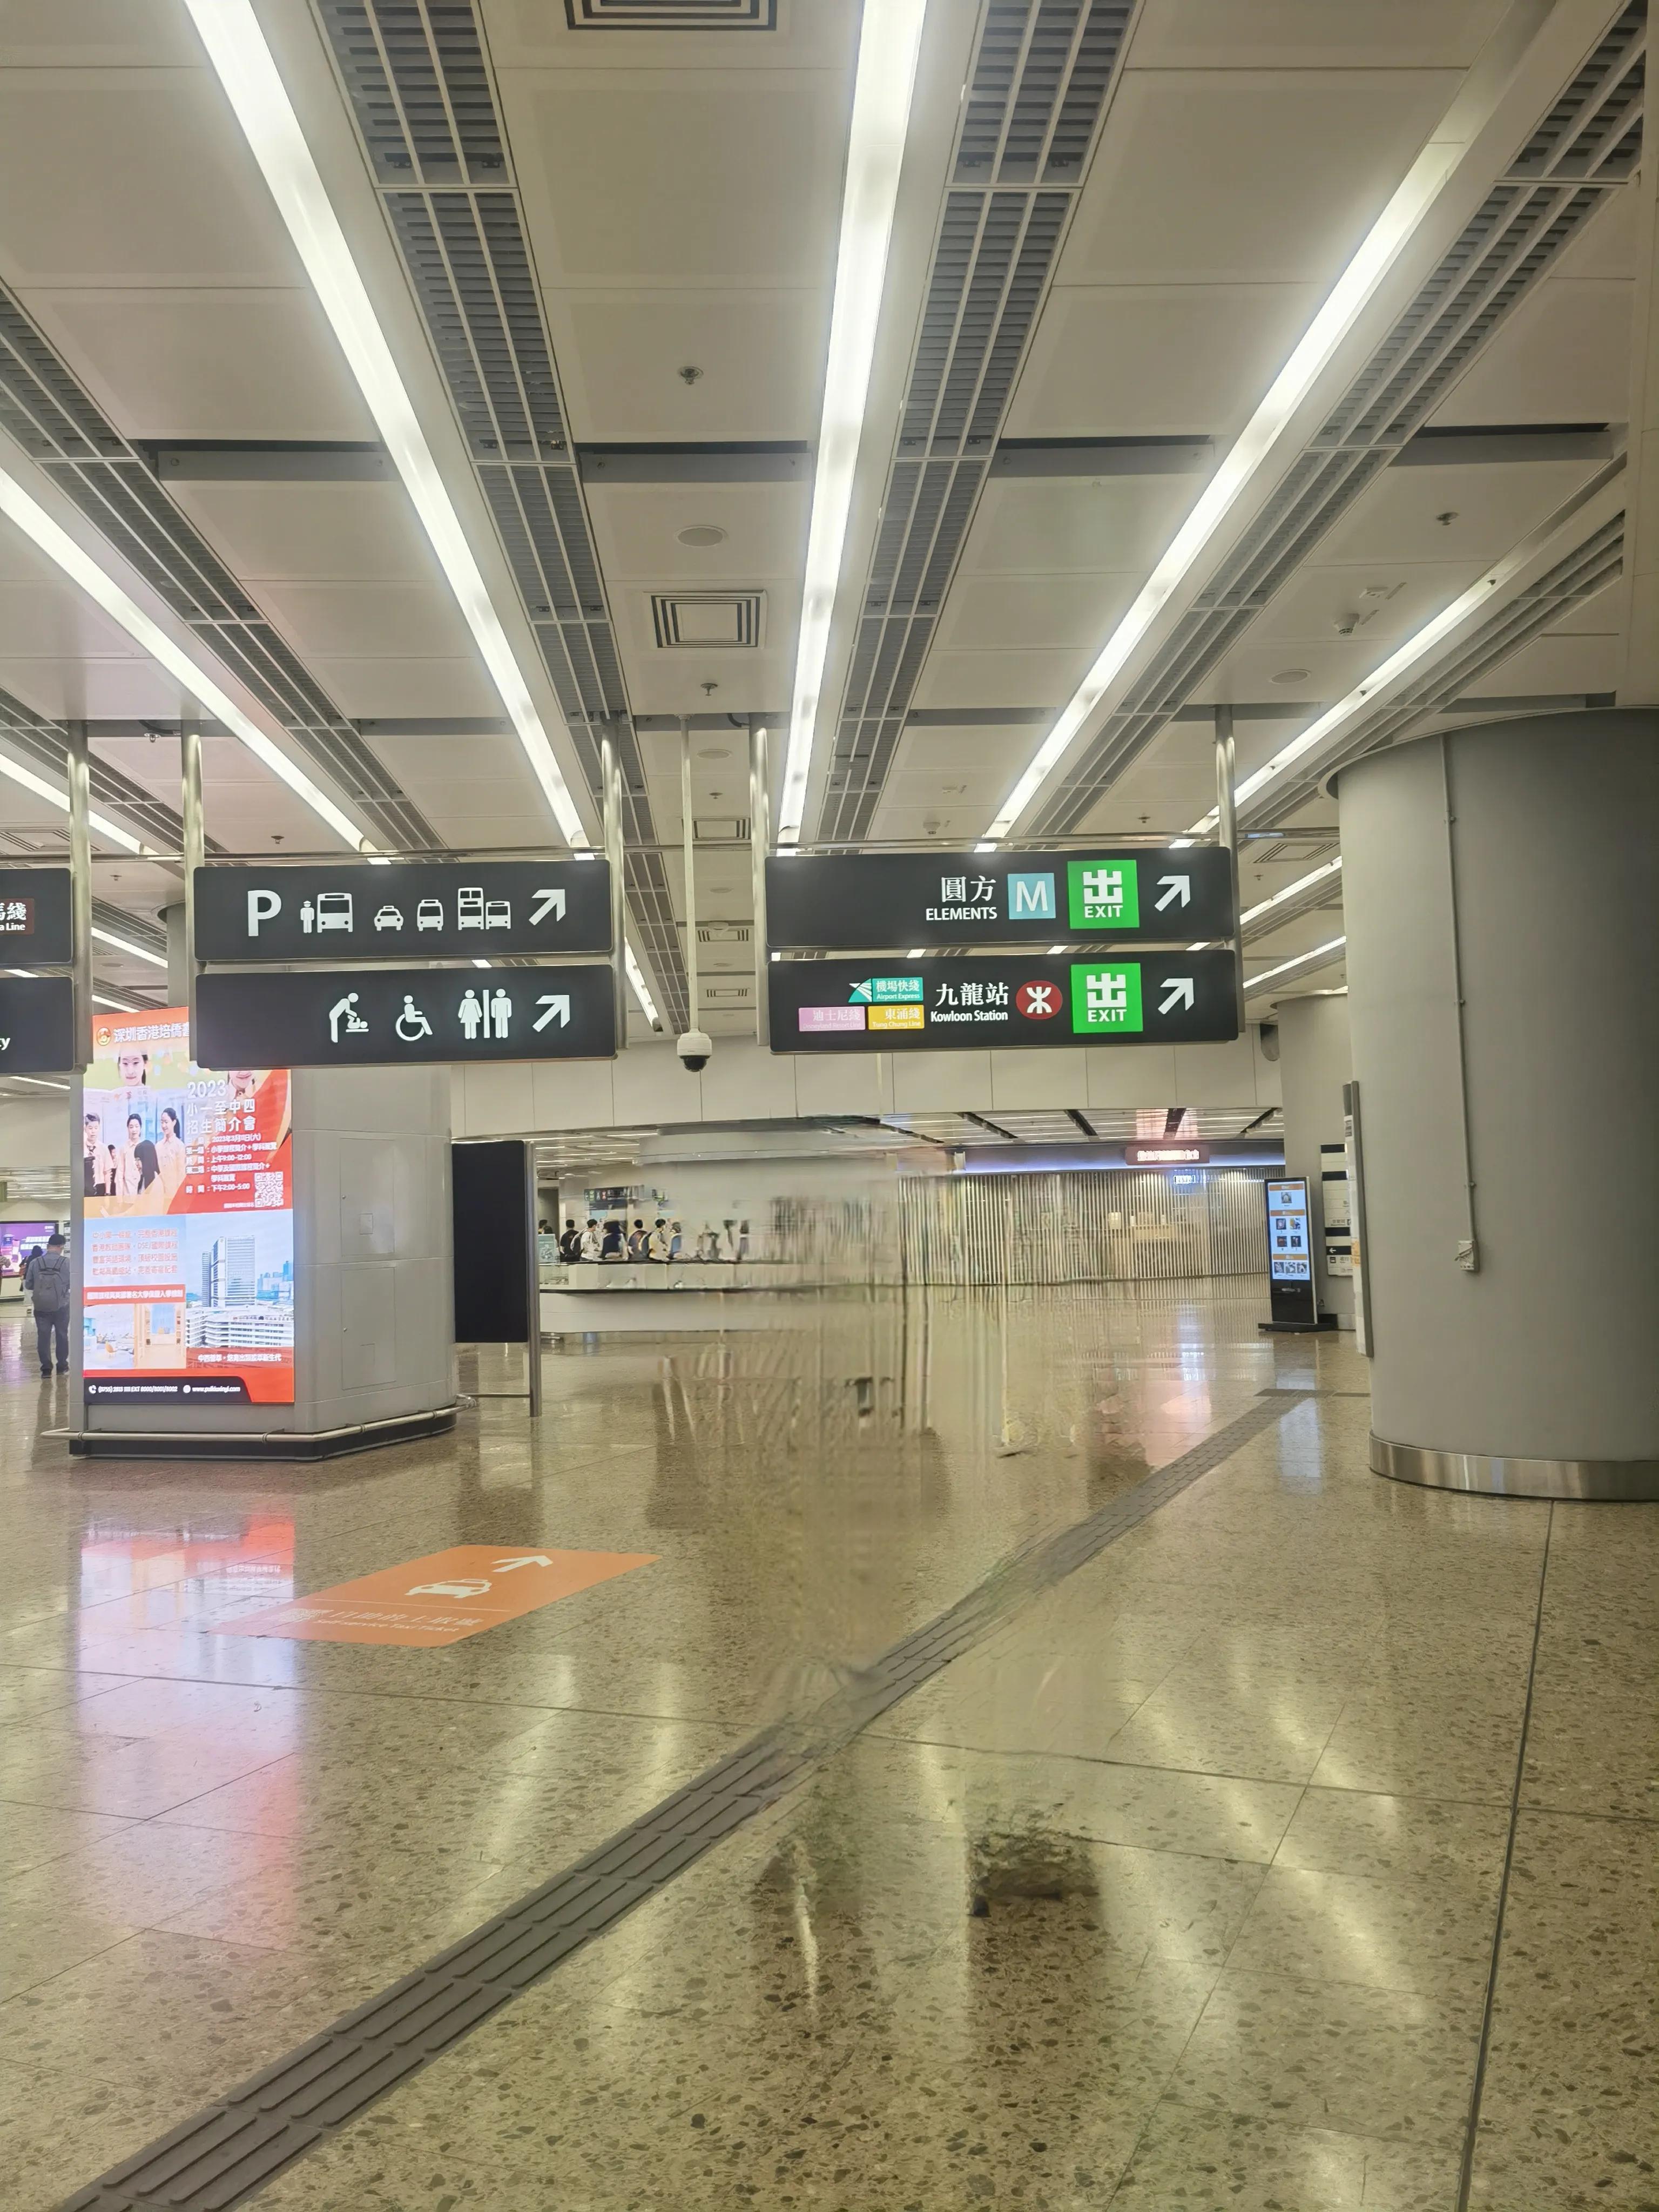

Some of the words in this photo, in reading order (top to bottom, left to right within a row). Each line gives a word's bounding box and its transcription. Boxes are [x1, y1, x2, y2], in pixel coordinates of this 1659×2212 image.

[941, 875, 996, 902] 圓方
[1083, 869, 1123, 904] 出
[1016, 881, 1048, 912] M
[926, 907, 997, 921] ELEMENTS
[1084, 905, 1123, 918] EXIT
[6, 922, 25, 930] Line
[935, 982, 1009, 1007] 九龍站
[1087, 973, 1127, 1008] 出
[930, 1010, 973, 1022] Kowloon
[974, 1010, 1008, 1022] Station
[1088, 1009, 1127, 1022] EXIT
[187, 1080, 227, 1099] 2023
[187, 1098, 255, 1117] 小一至中四
[187, 1115, 256, 1135] 招生簡介會
